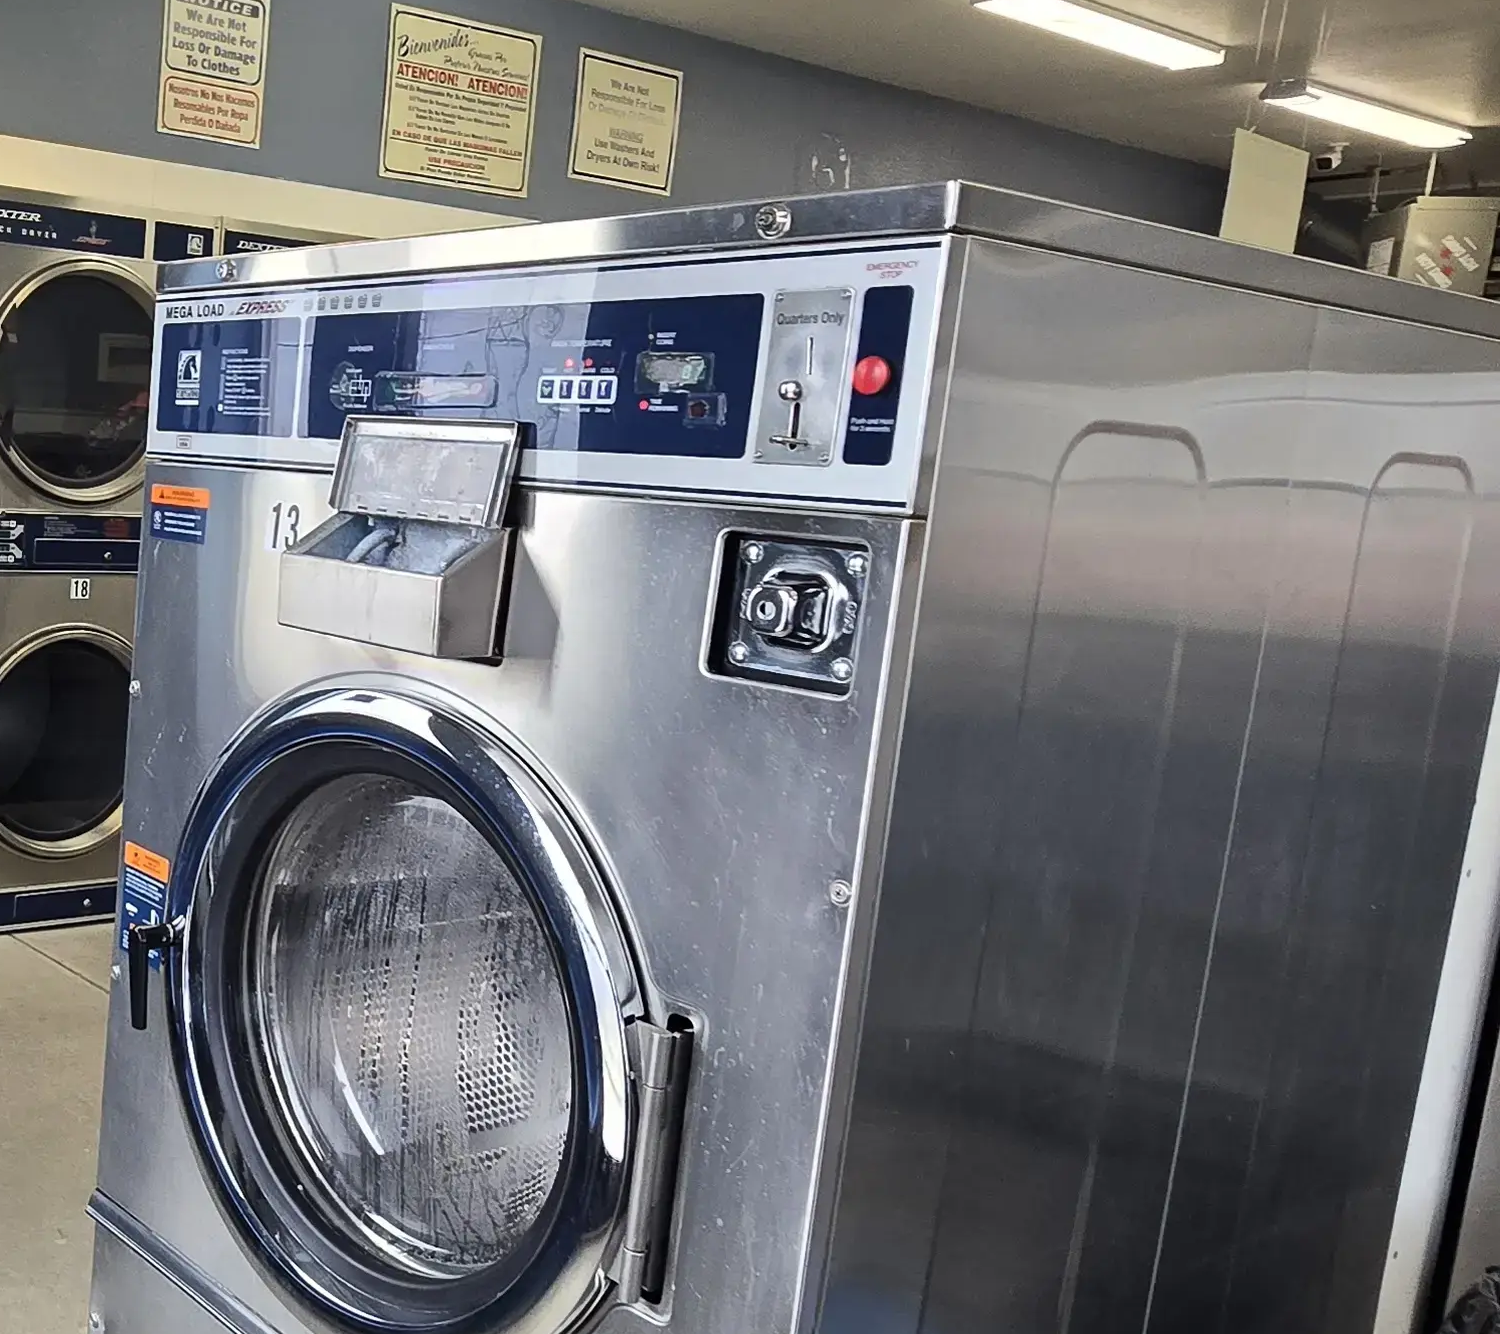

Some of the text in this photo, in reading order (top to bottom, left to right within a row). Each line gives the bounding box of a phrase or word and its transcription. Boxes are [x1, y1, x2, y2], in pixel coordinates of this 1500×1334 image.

[186, 8, 247, 33] We Are Not
[173, 21, 258, 50] Responsible For
[172, 37, 257, 65] Loss Or Damage
[186, 54, 241, 76] To Clothes
[397, 63, 528, 99] ATENCION! ATENCION!
[586, 150, 611, 164] Dryers
[237, 240, 288, 252] DEXT
[166, 300, 288, 319] MEGA LOAD EXPRESS
[777, 311, 845, 327] Quarters Only
[272, 502, 300, 552] 13
[74, 580, 88, 598] 18
